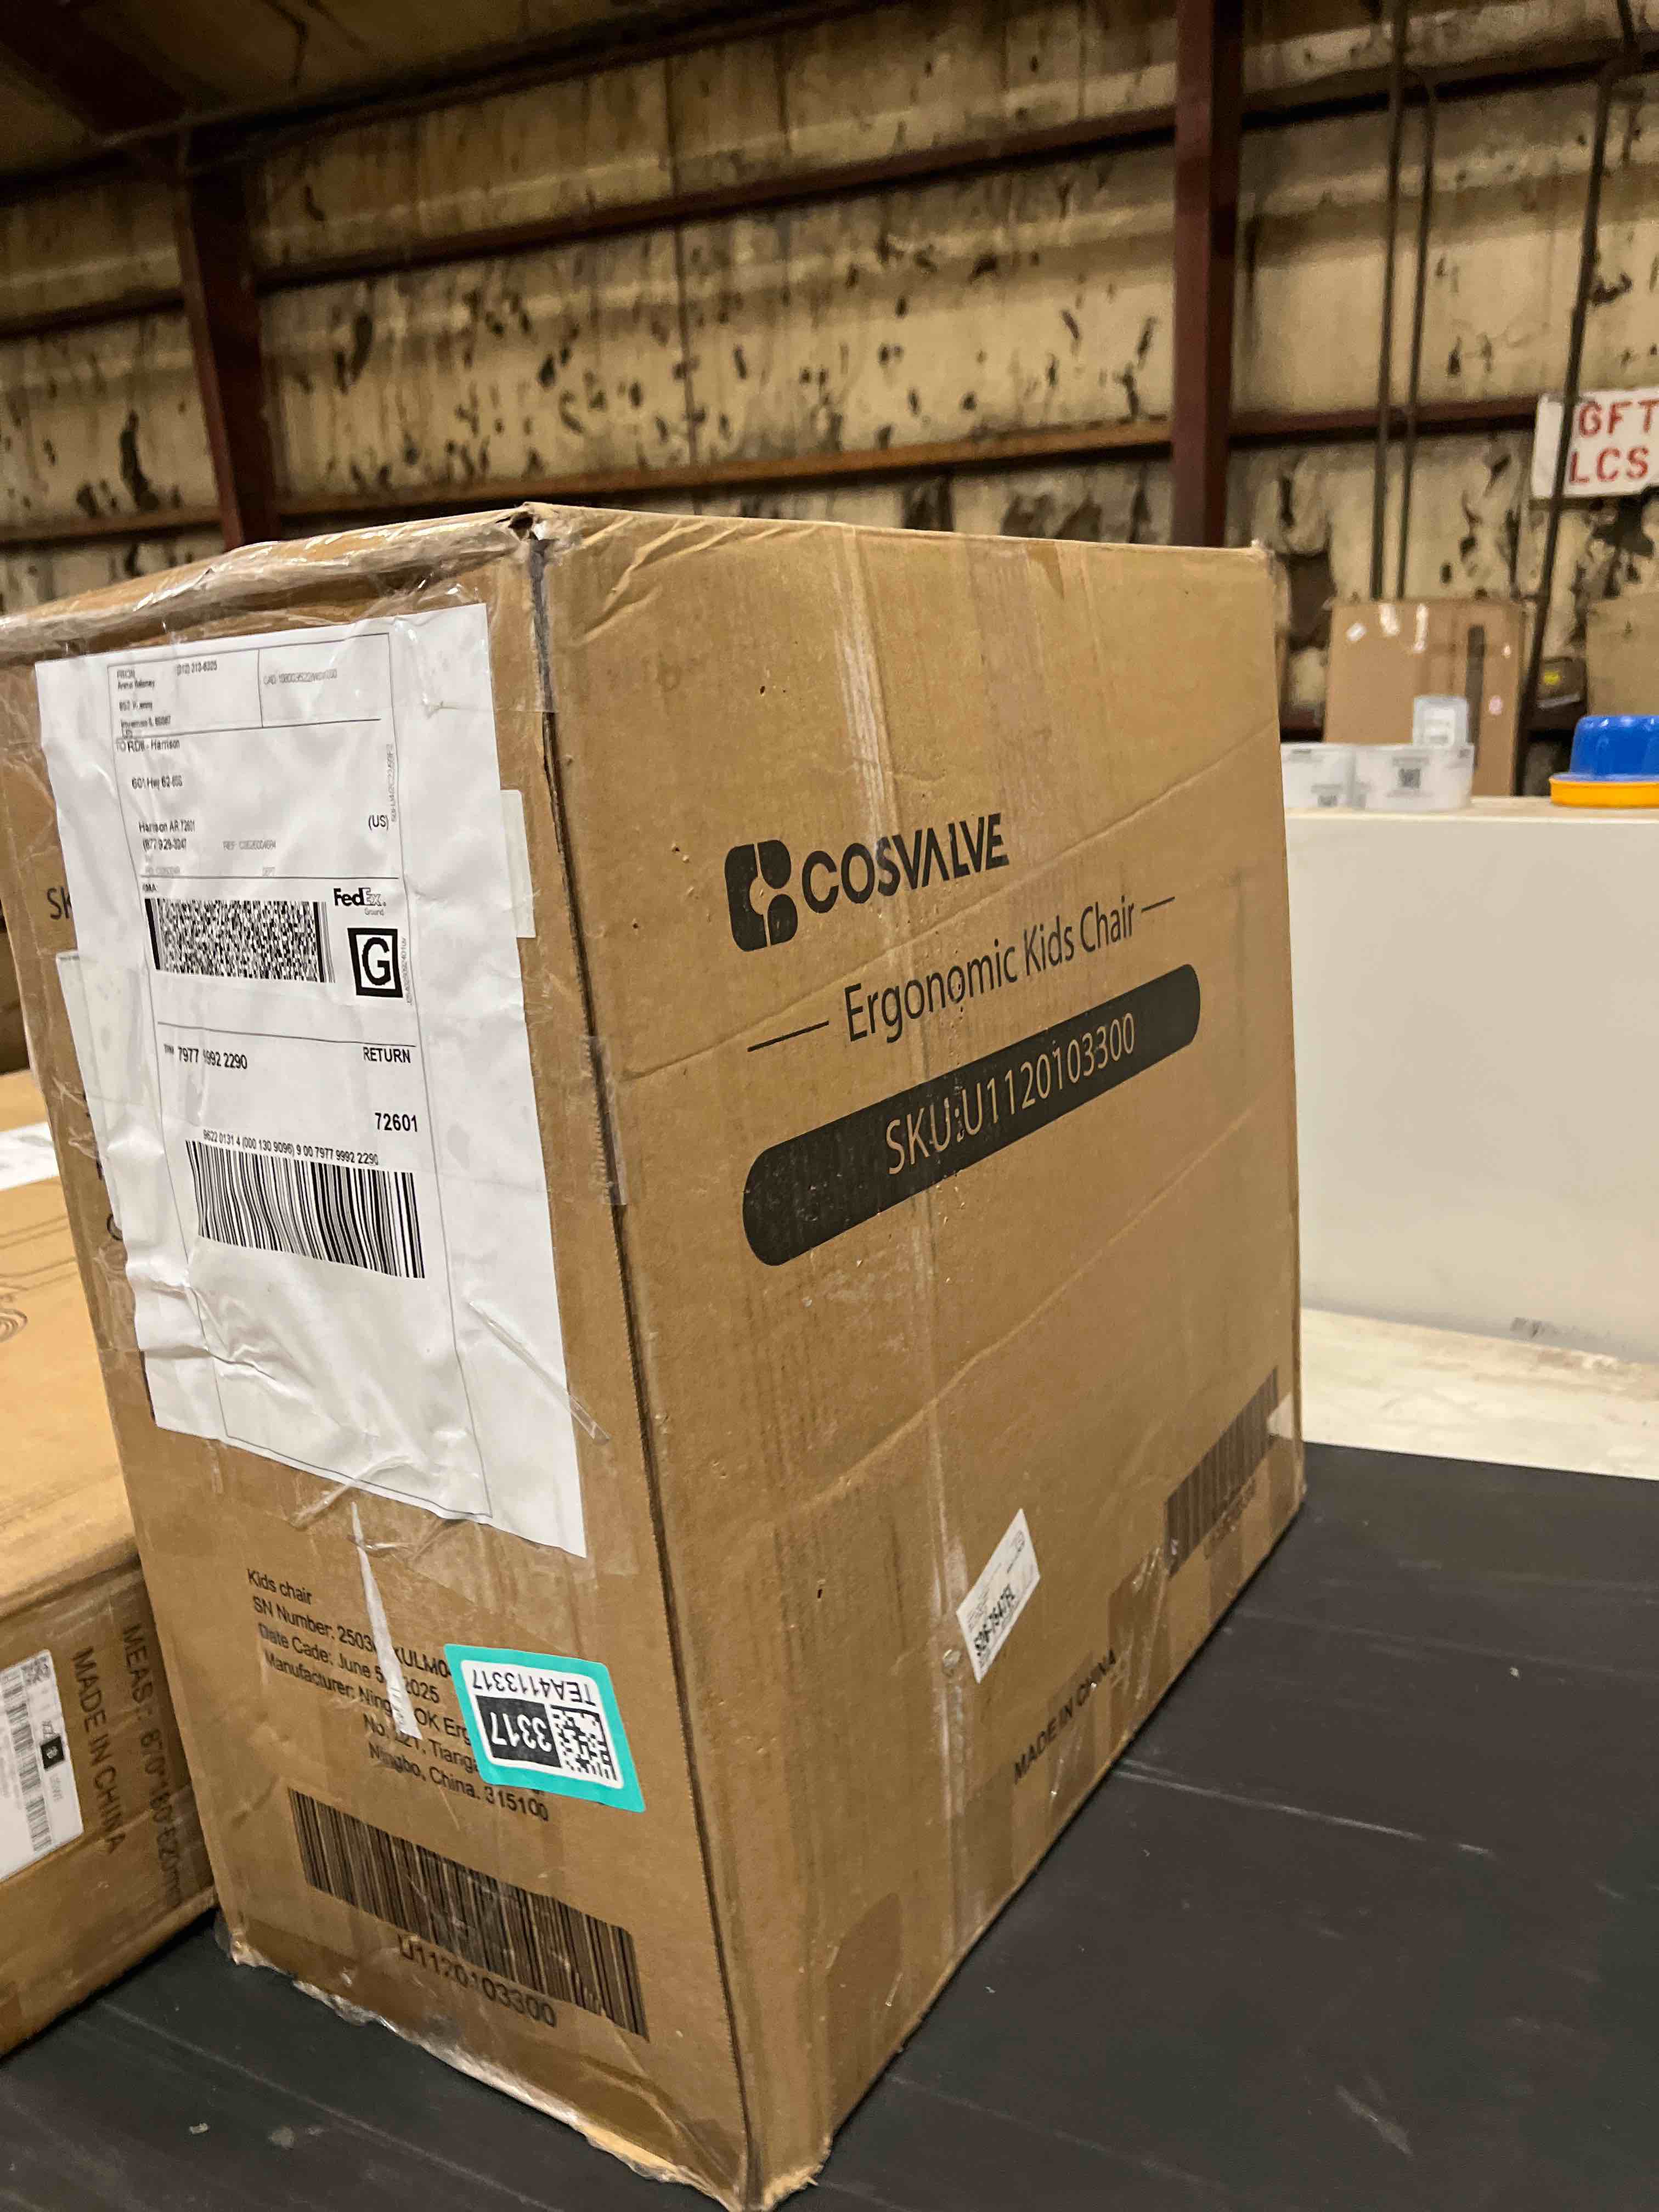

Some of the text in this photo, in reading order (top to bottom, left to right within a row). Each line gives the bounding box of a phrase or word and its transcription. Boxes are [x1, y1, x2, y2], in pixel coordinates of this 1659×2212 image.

[1579, 399, 1659, 436] GFT
[1570, 447, 1649, 484] LCS
[151, 739, 180, 751] Harrison
[368, 815, 388, 831] (US)
[802, 812, 1010, 914] COSVALVE
[334, 888, 382, 906] FedEx
[362, 936, 391, 986] G
[844, 894, 1136, 1044] Ergonomic Kids Chair
[178, 1046, 199, 1063] 7977
[223, 1052, 247, 1069] 2290
[363, 1046, 411, 1064] RETURN
[886, 1012, 1136, 1175] SKU:U1120103300
[374, 1112, 417, 1132] 72601
[258, 1139, 272, 1152] 130
[296, 1144, 301, 1155] 9
[303, 1145, 313, 1157] 00
[315, 1146, 334, 1160] 7977
[357, 1152, 379, 1165] 2290
[247, 1568, 312, 1605] Kids chair
[253, 1595, 274, 1617] SN
[276, 1602, 335, 1640] Number:
[258, 1622, 290, 1649] Date
[338, 1652, 371, 1679] June
[471, 1668, 597, 1707] TEA4113317
[72, 1646, 126, 1855] MADE IN CHINA
[490, 1711, 552, 1753] 3317
[484, 1786, 549, 1822] 315100
